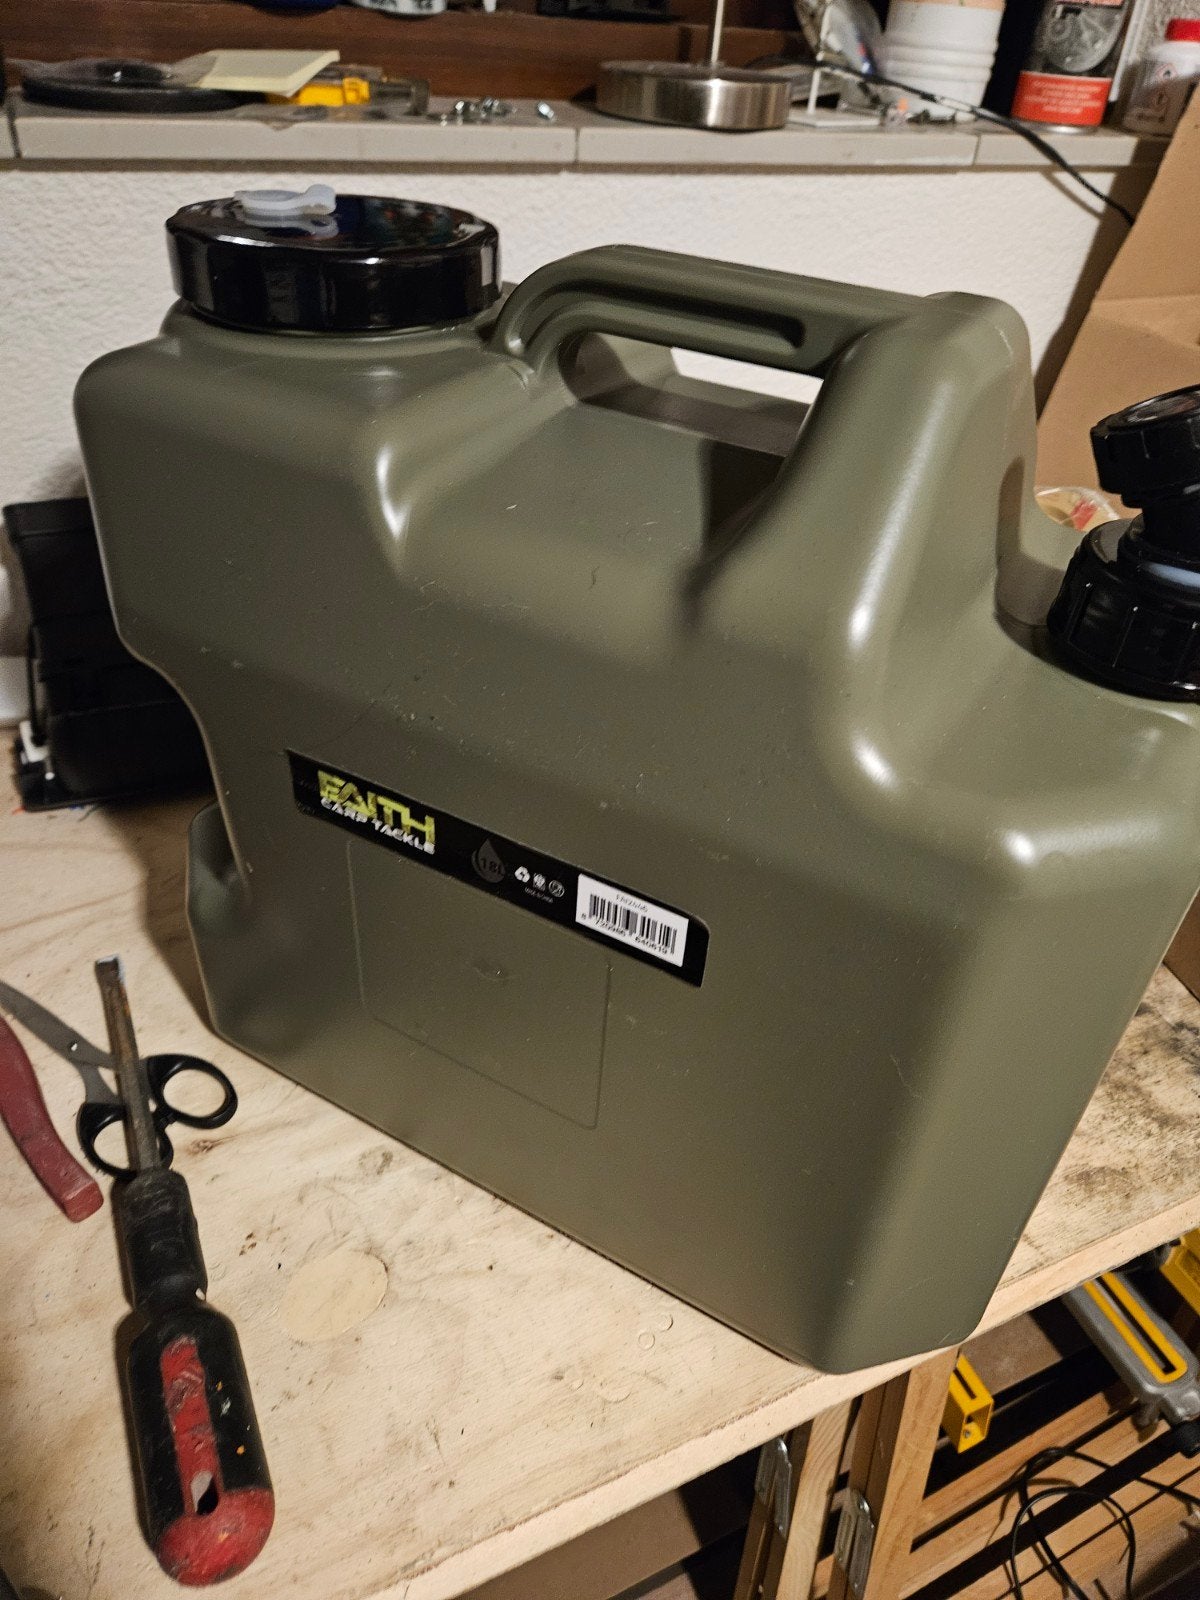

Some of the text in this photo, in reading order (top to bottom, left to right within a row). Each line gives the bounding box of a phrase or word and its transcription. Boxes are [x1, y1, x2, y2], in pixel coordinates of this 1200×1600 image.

[317, 770, 435, 845] FAITH
[321, 797, 435, 855] CARP TACKLE
